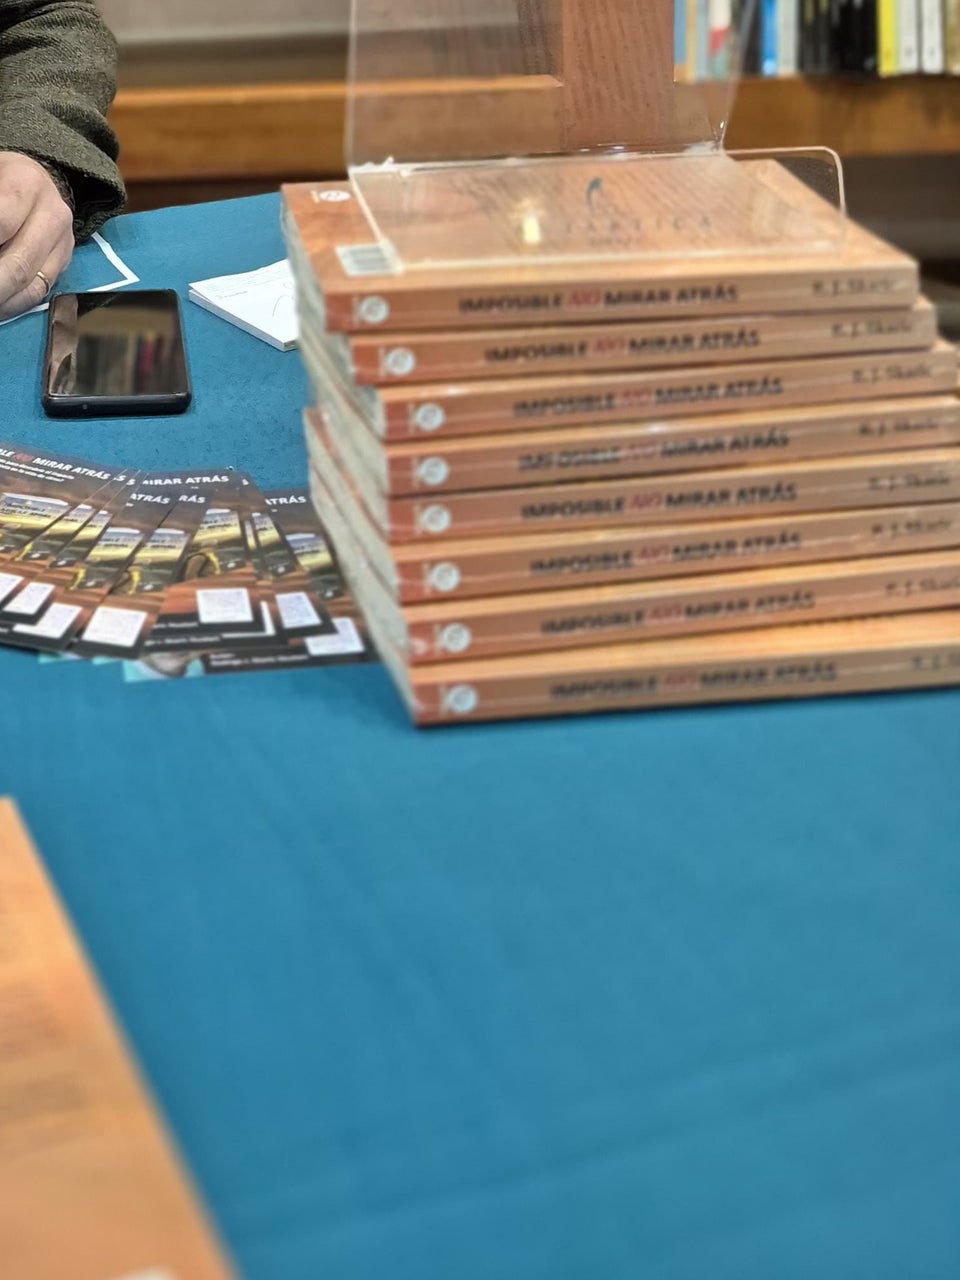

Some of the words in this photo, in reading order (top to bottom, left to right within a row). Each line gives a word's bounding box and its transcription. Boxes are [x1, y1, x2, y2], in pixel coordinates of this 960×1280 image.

[459, 293, 563, 315] IMPOSIBLE
[603, 287, 671, 308] MIRAR
[676, 284, 739, 303] ATRÁS
[484, 341, 588, 363] IMPOSIBLE
[628, 334, 694, 355] MIRAR
[699, 329, 762, 349] ATRÁS
[32, 457, 73, 471] MIRAR
[71, 465, 112, 480] ATRÁS
[185, 474, 230, 485] ATRÁS
